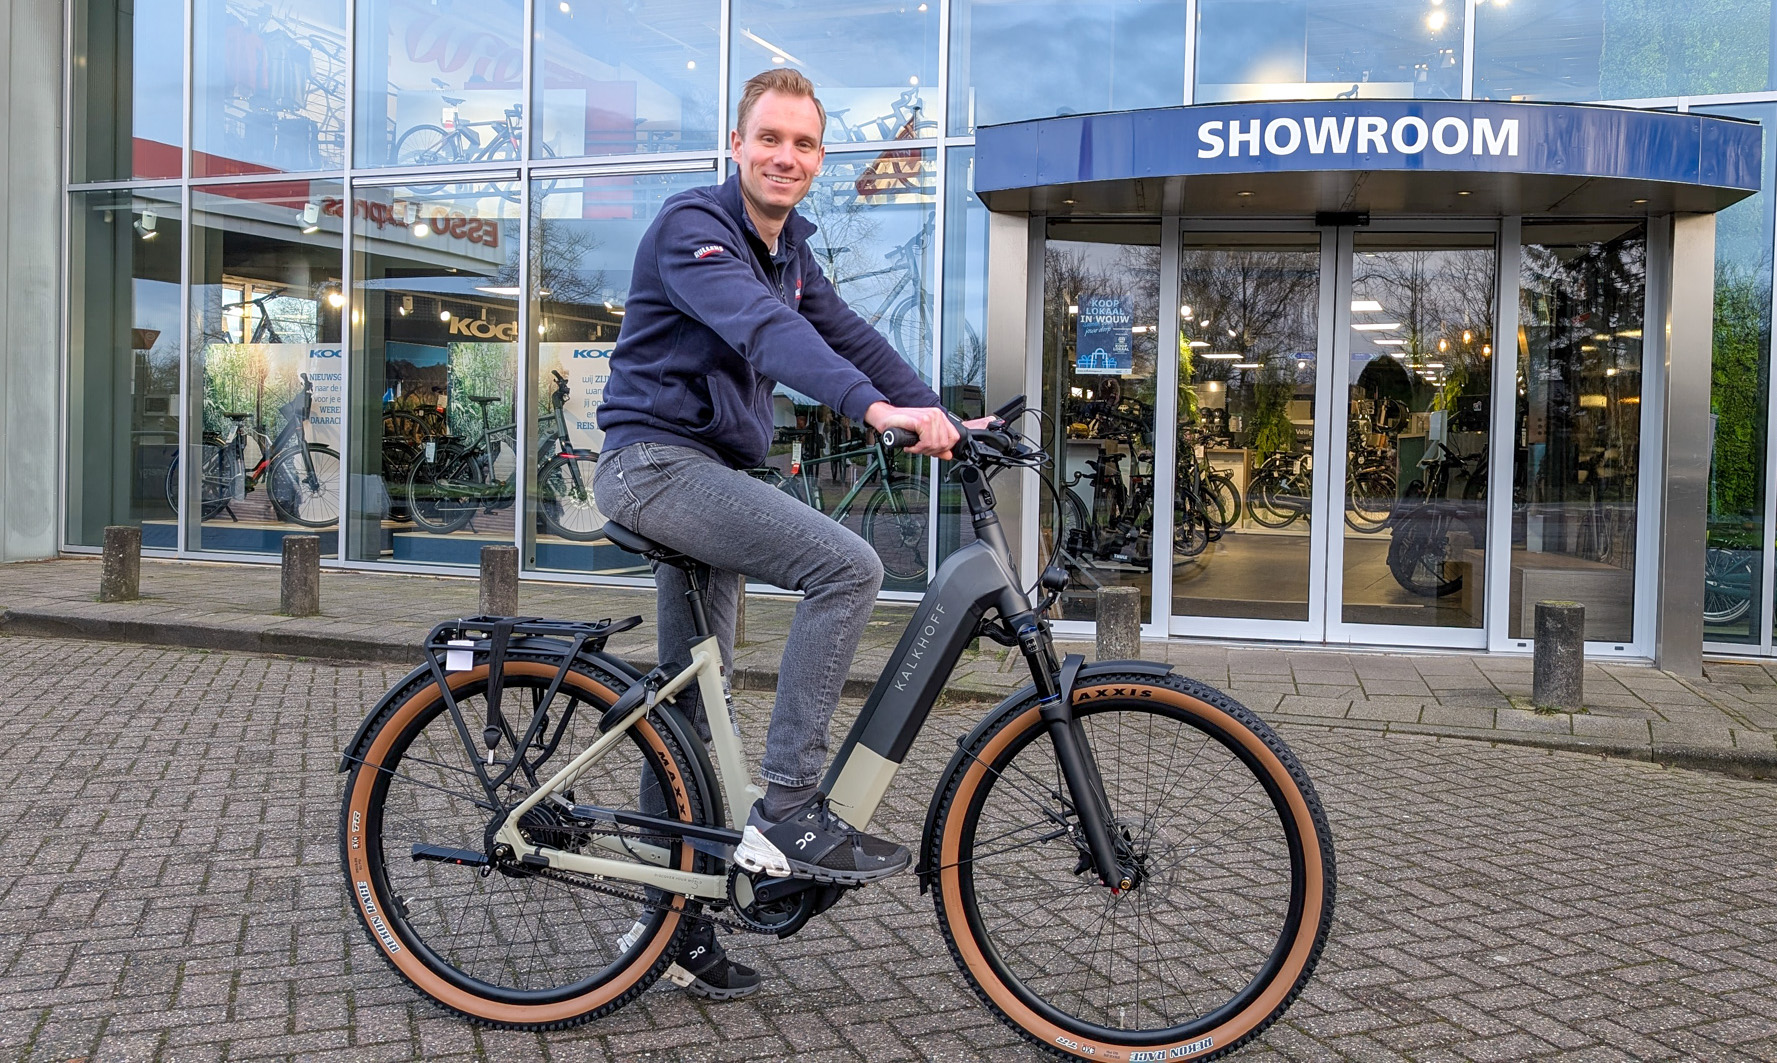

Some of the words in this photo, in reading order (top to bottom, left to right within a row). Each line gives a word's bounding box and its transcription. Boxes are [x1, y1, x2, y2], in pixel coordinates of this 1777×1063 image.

[1197, 116, 1519, 158] SHOWROOM
[1091, 299, 1119, 308] KOOP
[1086, 307, 1125, 316] LOKAAL
[1080, 315, 1092, 323] IN
[1096, 315, 1130, 323] WOUW
[330, 383, 339, 392] de
[577, 421, 595, 430] REIS
[894, 603, 946, 692] KALKHOFF
[356, 881, 378, 915] RACE
[370, 915, 401, 954] REKON
[1169, 1036, 1213, 1059] REKON
[1128, 1049, 1167, 1062] RACE
